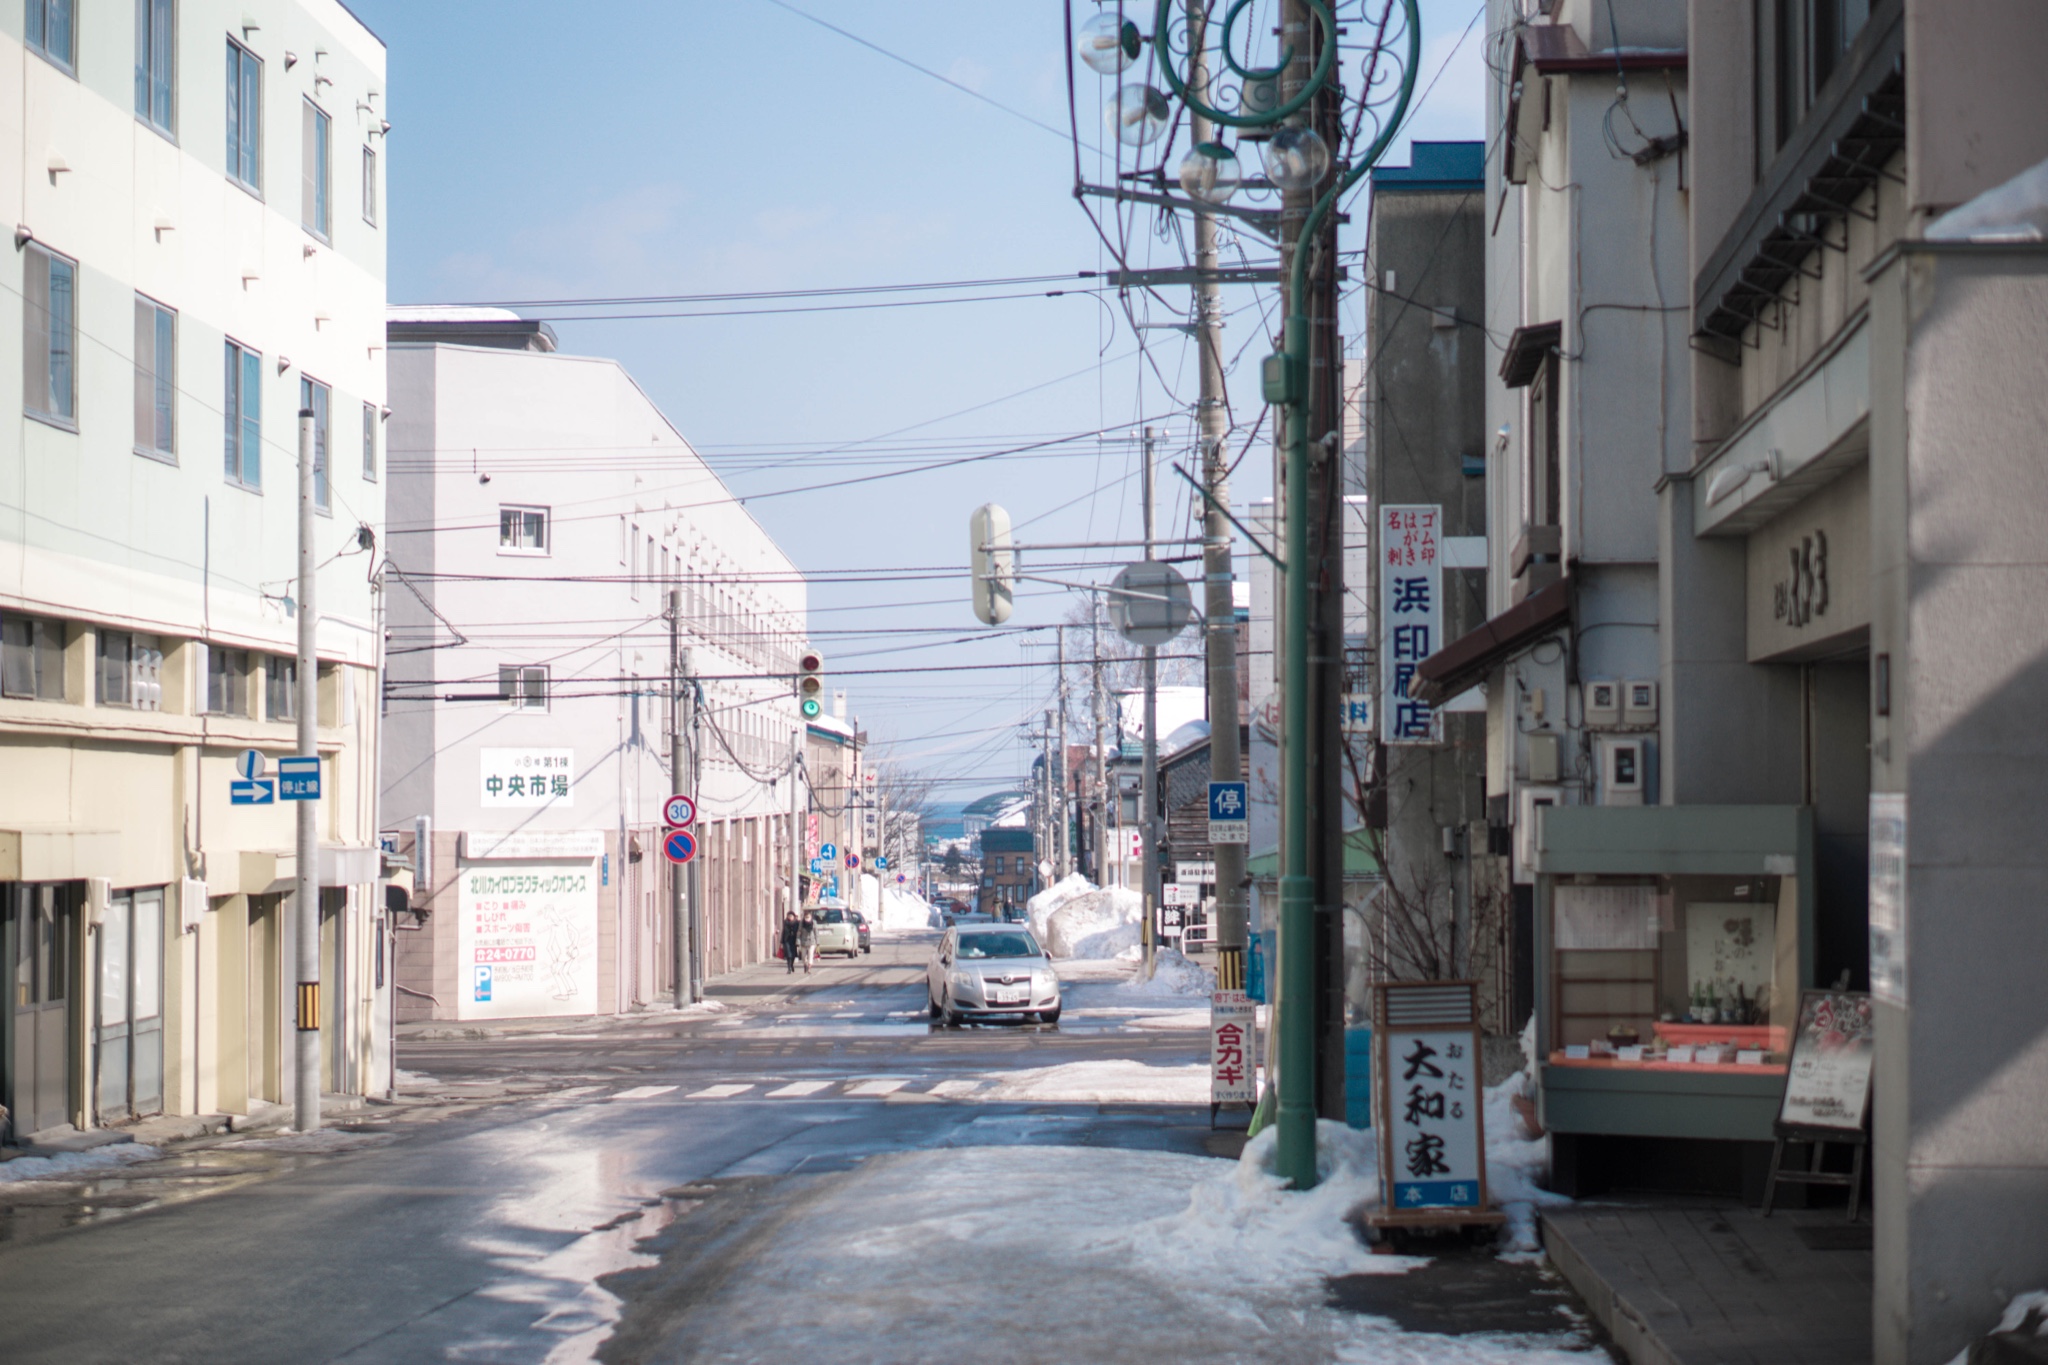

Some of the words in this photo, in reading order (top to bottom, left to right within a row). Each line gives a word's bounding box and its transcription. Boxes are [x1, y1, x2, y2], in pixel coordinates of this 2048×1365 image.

[1387, 511, 1402, 566] 名刺
[1403, 511, 1419, 566] はがき
[1420, 511, 1437, 566] ゴム印
[281, 780, 319, 795] 停止線
[486, 774, 569, 797] 中央市場
[670, 803, 689, 819] 30
[1214, 788, 1241, 814] 停
[1210, 832, 1246, 841] ここまで
[470, 875, 587, 895] 北川カイロプラクティックオフィス
[483, 901, 499, 911] こり
[483, 912, 507, 923] しびれ
[485, 947, 535, 961] 24-0770
[475, 967, 491, 987] P
[1215, 1022, 1244, 1086] 合カギ
[1446, 1042, 1465, 1119] おたる
[1402, 1039, 1451, 1178] 大和家
[1403, 1185, 1470, 1203] 本店
